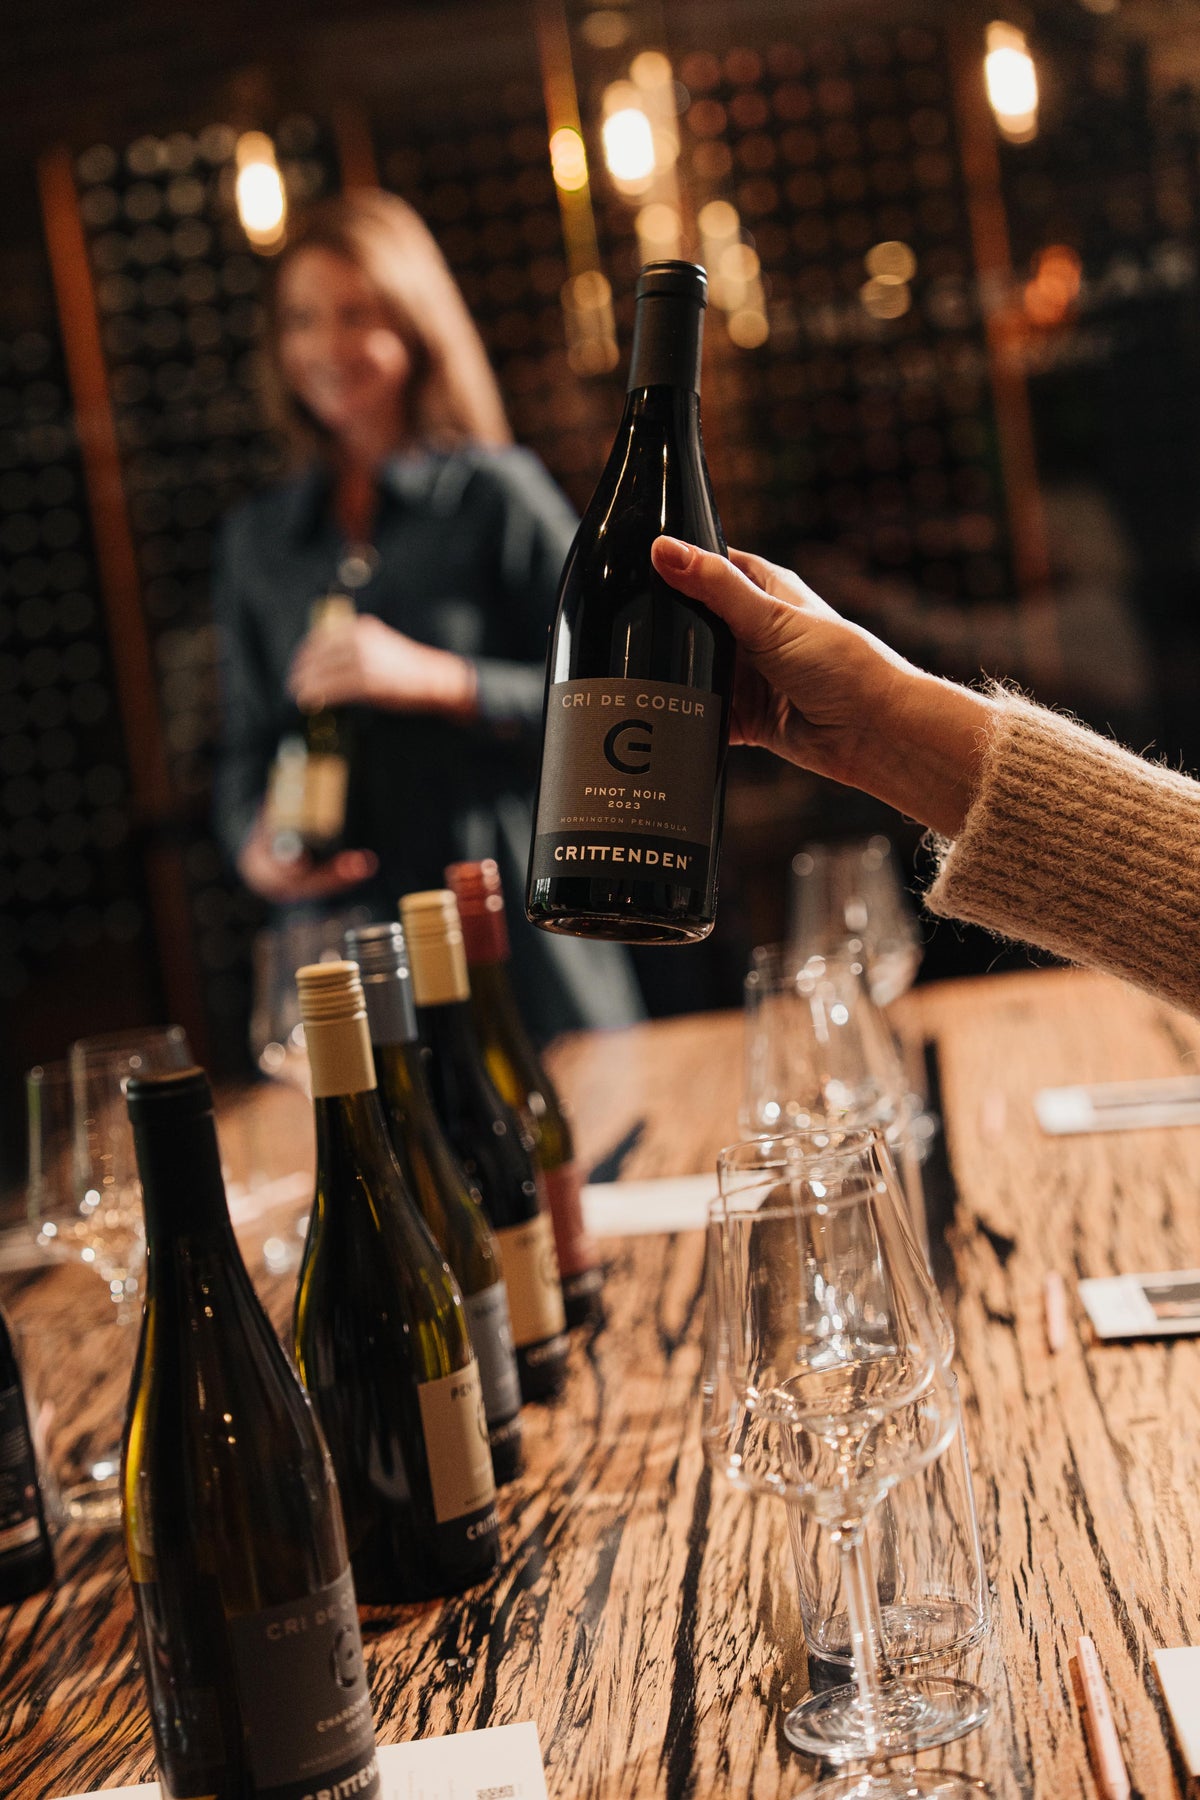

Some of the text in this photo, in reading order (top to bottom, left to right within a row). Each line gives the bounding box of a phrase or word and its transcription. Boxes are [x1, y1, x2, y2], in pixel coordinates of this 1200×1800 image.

[562, 692, 705, 718] CRI DE COEUR
[585, 787, 666, 801] PINOT NOIR
[608, 800, 641, 810] 2023
[631, 818, 688, 832] PENINSULA
